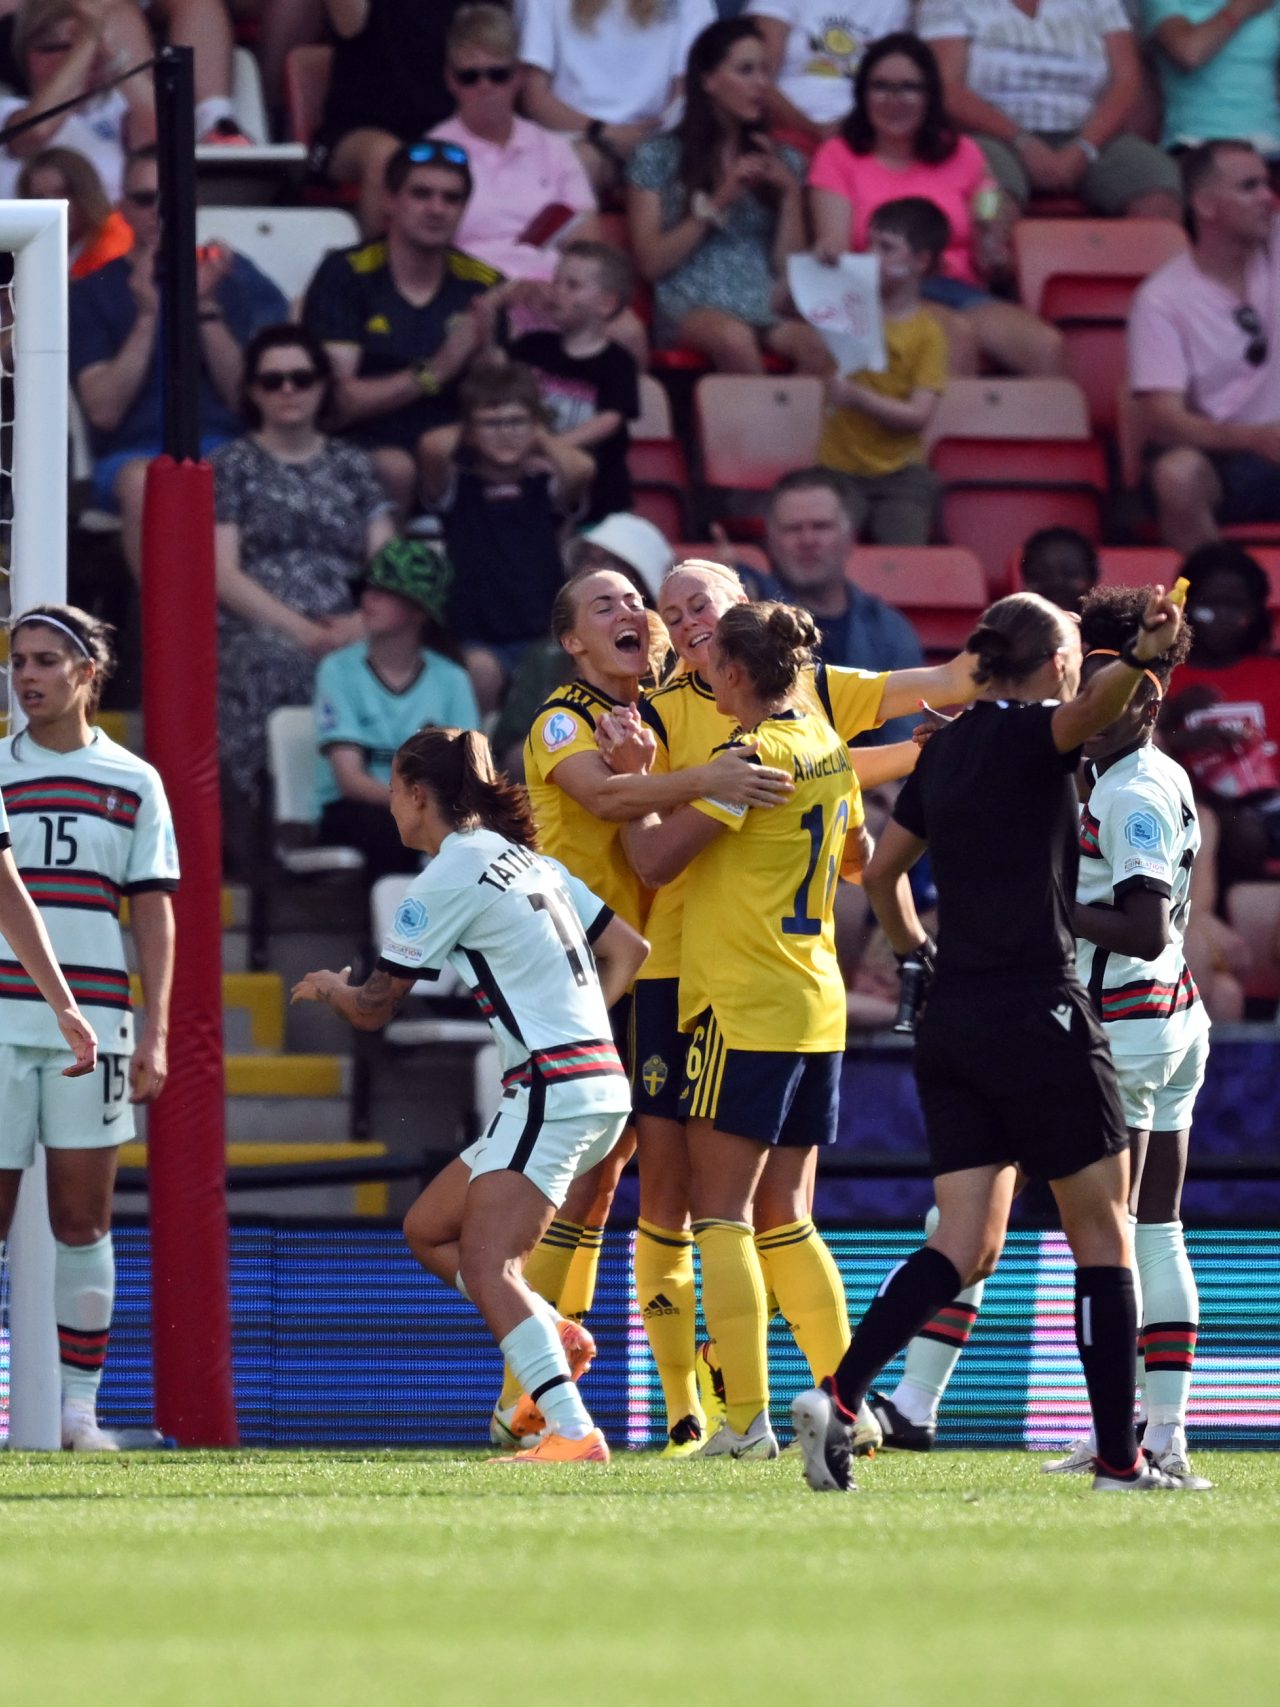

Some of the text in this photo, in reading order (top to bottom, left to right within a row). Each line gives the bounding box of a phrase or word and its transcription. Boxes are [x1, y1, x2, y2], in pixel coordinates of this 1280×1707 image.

[38, 815, 78, 866] 15
[478, 844, 557, 892] TATIA
[97, 1054, 126, 1104] 15
